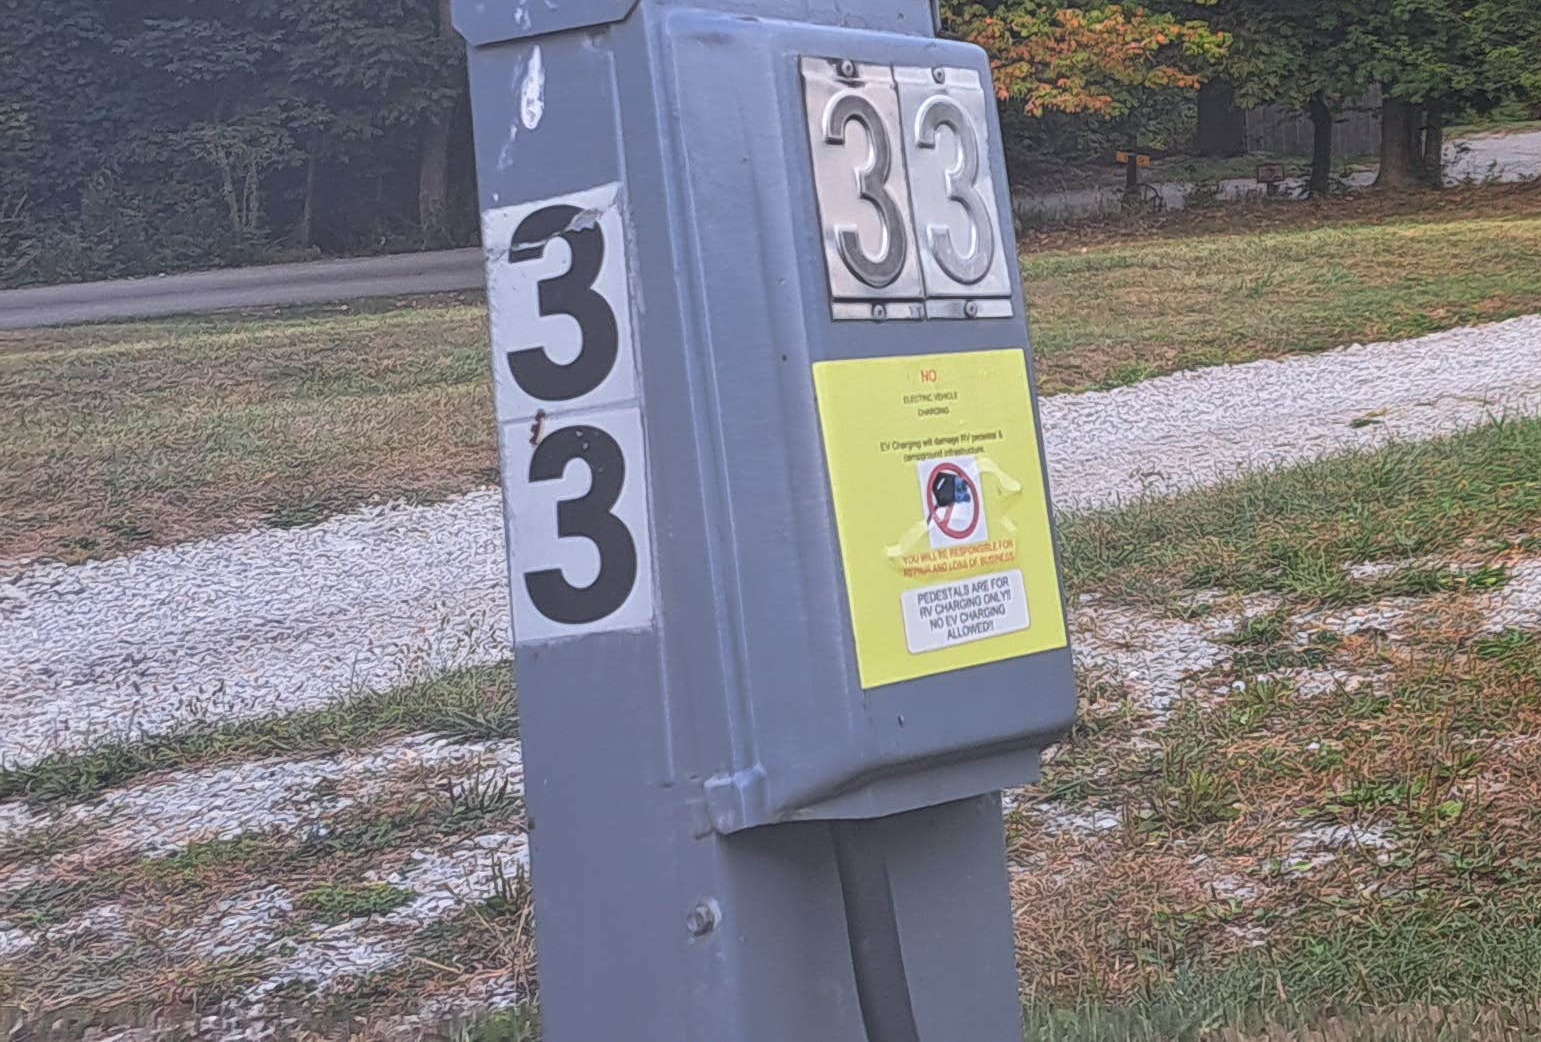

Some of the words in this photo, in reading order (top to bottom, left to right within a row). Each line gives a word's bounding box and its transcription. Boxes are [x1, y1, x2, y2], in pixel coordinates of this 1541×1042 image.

[822, 89, 995, 289] 33
[920, 369, 937, 383] NO
[903, 393, 933, 405] ELECTRIC
[880, 440, 891, 452] EV
[917, 584, 970, 605] PEDESTALS
[971, 579, 989, 593] ARE
[990, 576, 1010, 589] FOR
[919, 605, 932, 619] RV
[934, 595, 982, 615] CHARGING
[929, 618, 944, 631] NO
[945, 613, 958, 627] EV
[960, 603, 1006, 623] CHARGING
